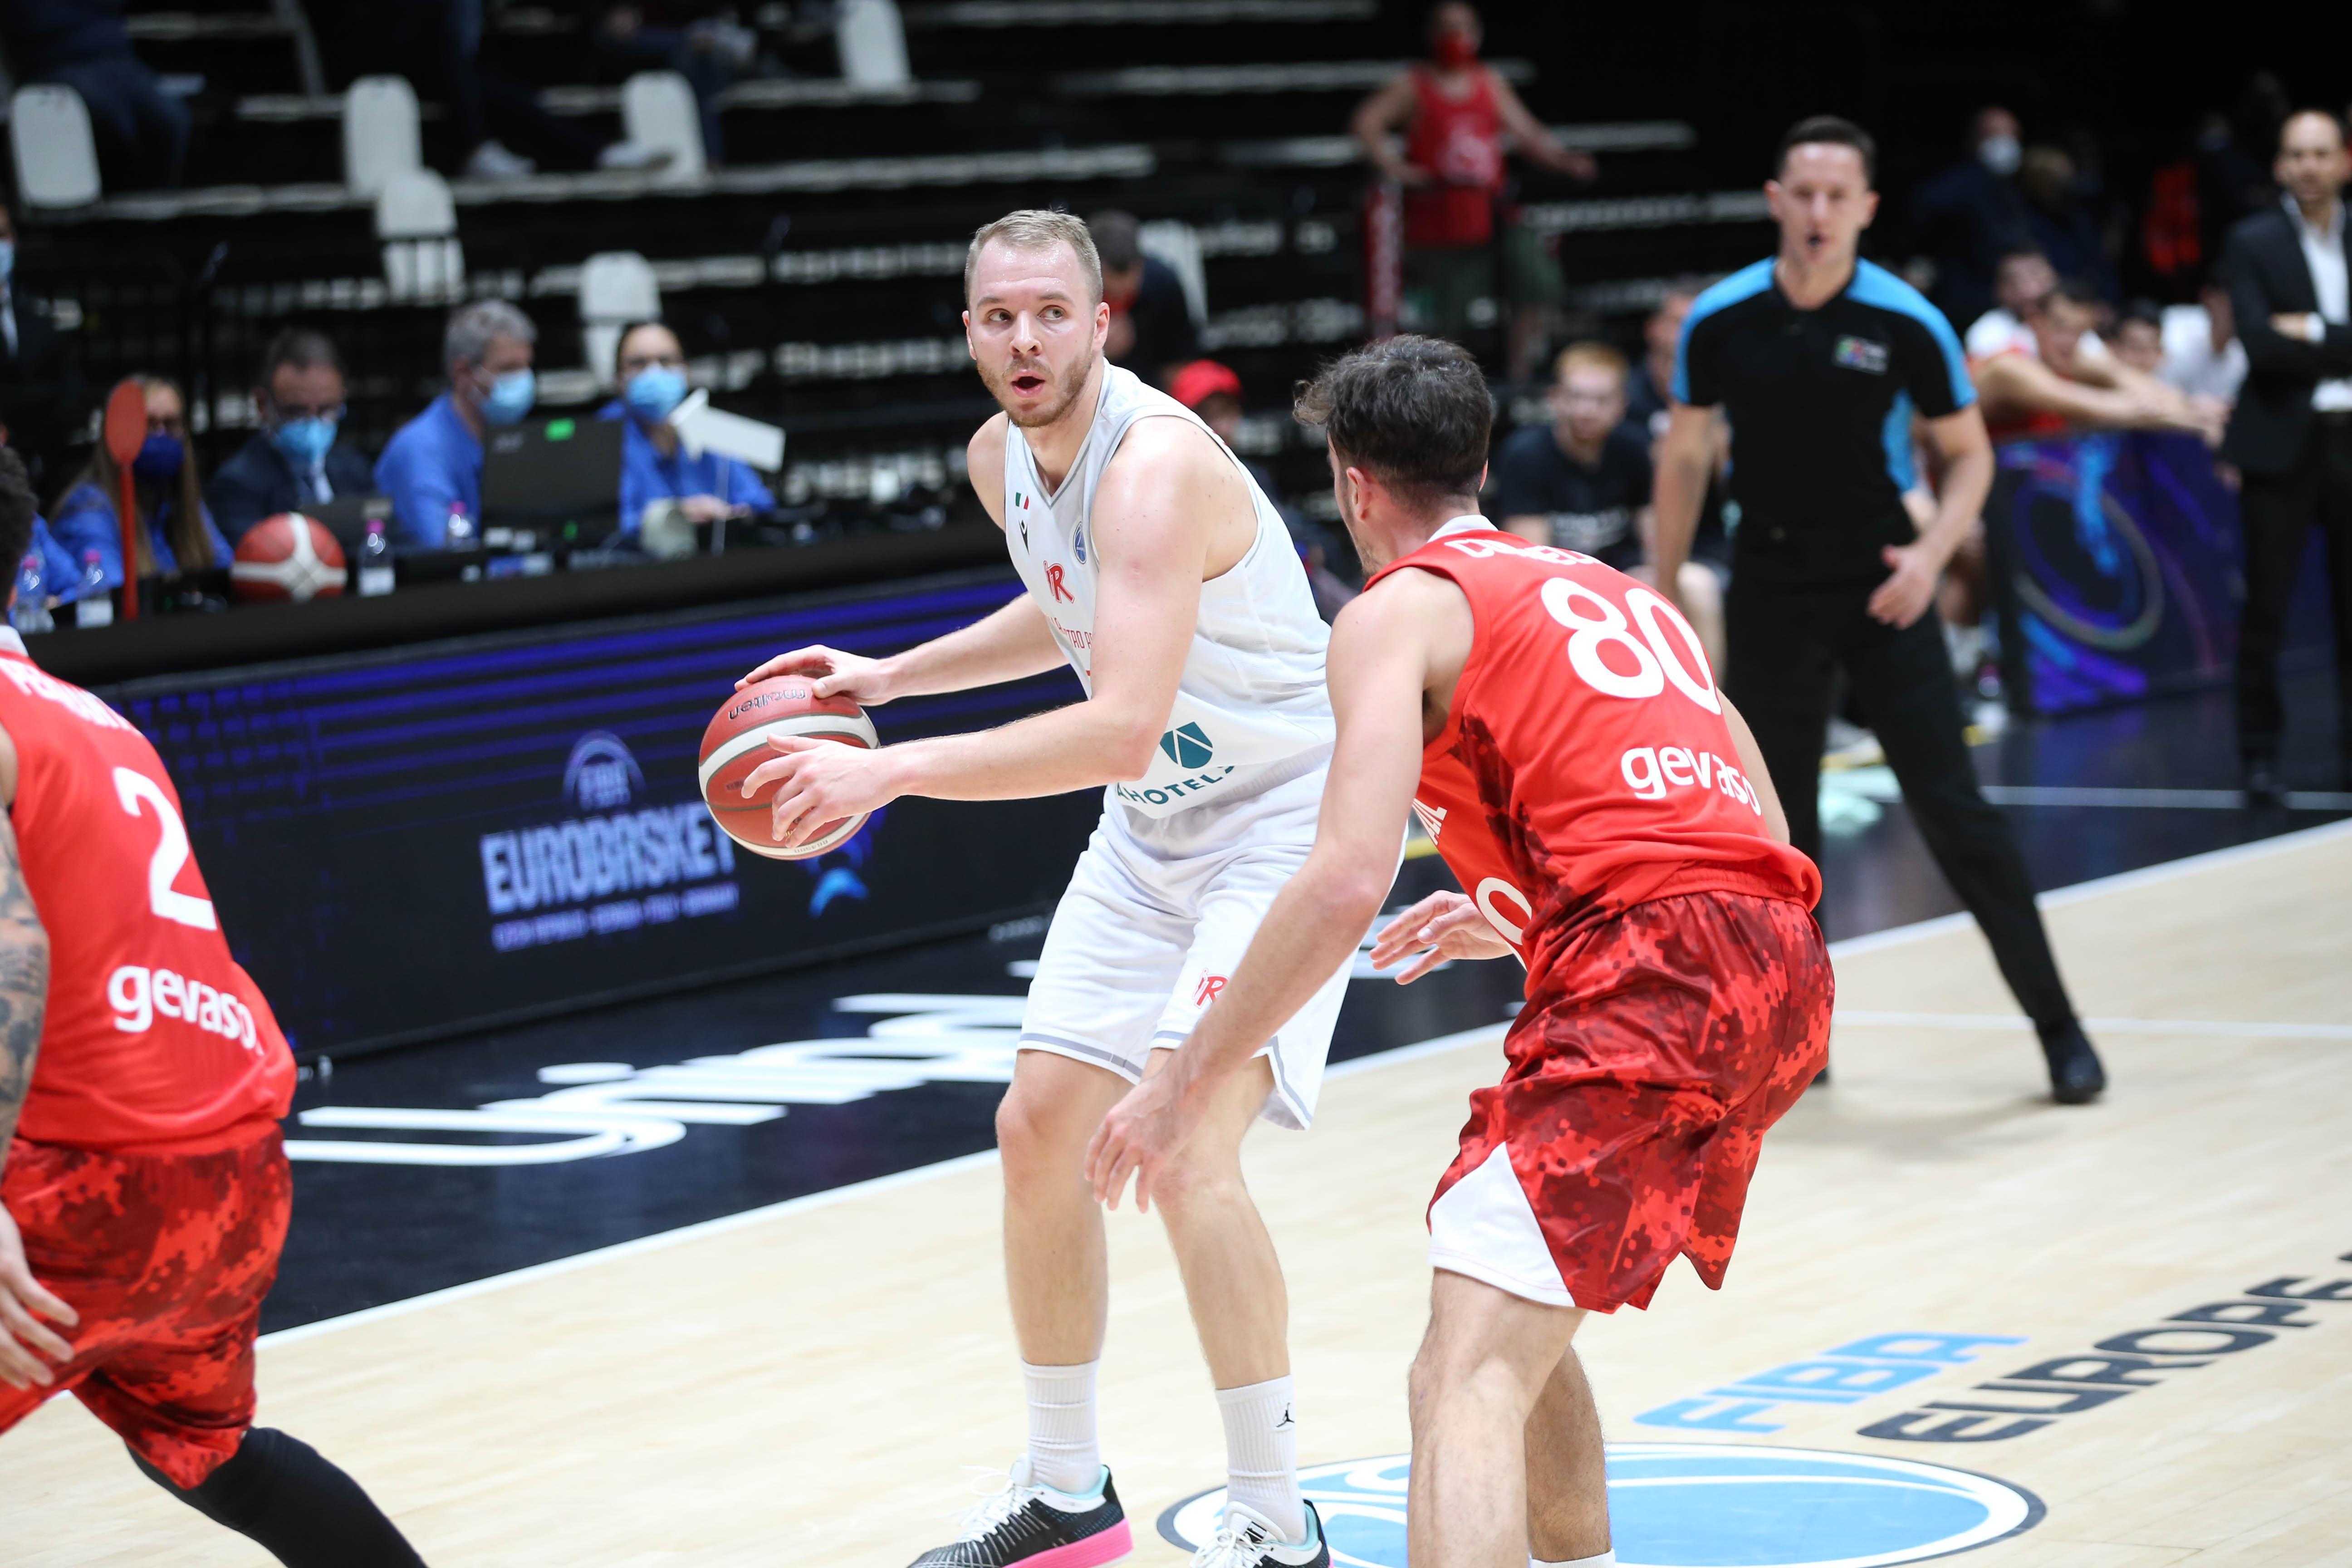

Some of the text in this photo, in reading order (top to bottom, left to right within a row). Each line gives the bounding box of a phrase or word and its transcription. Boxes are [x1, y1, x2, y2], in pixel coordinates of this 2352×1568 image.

[1541, 577, 1721, 715] 80
[728, 688, 806, 720] molten
[113, 767, 217, 931] 2
[107, 965, 264, 1056] gevaso
[1632, 1330, 2030, 1435] FIBA
